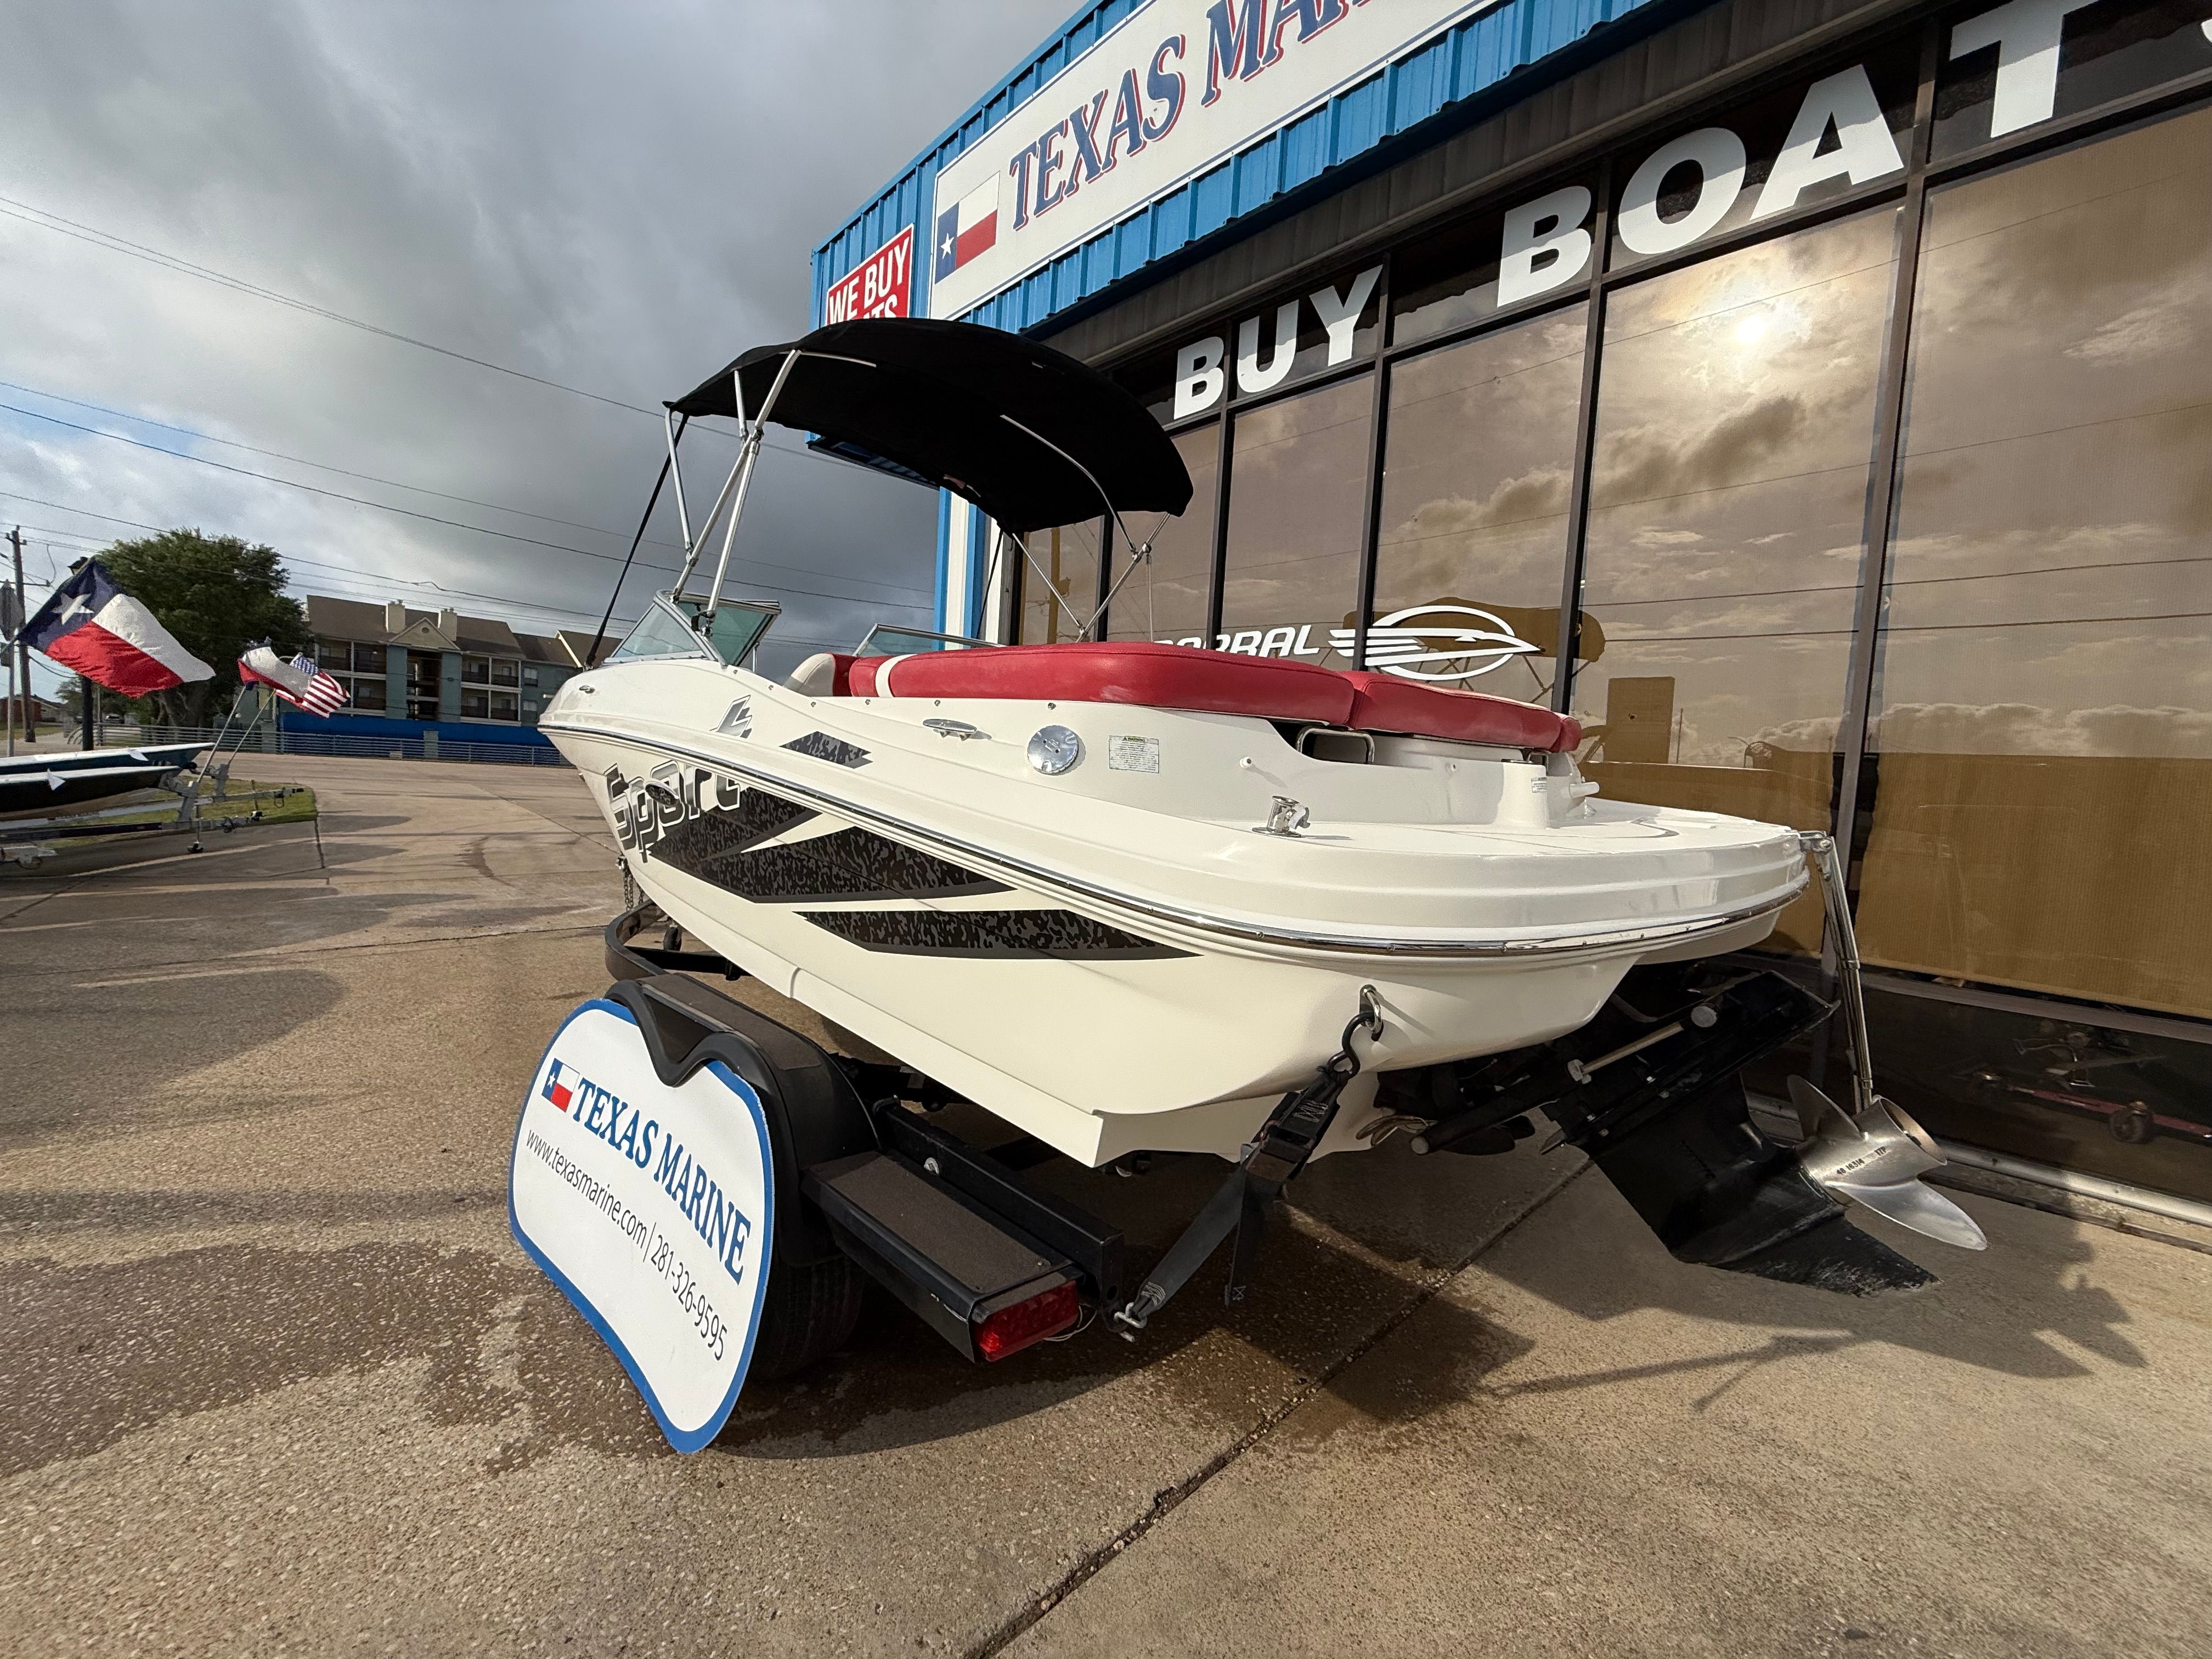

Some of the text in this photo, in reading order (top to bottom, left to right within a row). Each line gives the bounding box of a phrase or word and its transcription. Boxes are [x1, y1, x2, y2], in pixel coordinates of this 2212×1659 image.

[1009, 34, 1186, 231] TEXAS
[1174, 0, 2212, 419] BUY BOAT
[830, 275, 860, 324] WE
[864, 236, 910, 309] BUY
[527, 1128, 648, 1249] www.texasmarine.com
[651, 1234, 727, 1361] 281-326-9595
[572, 1077, 751, 1285] TEXAS MARINE
